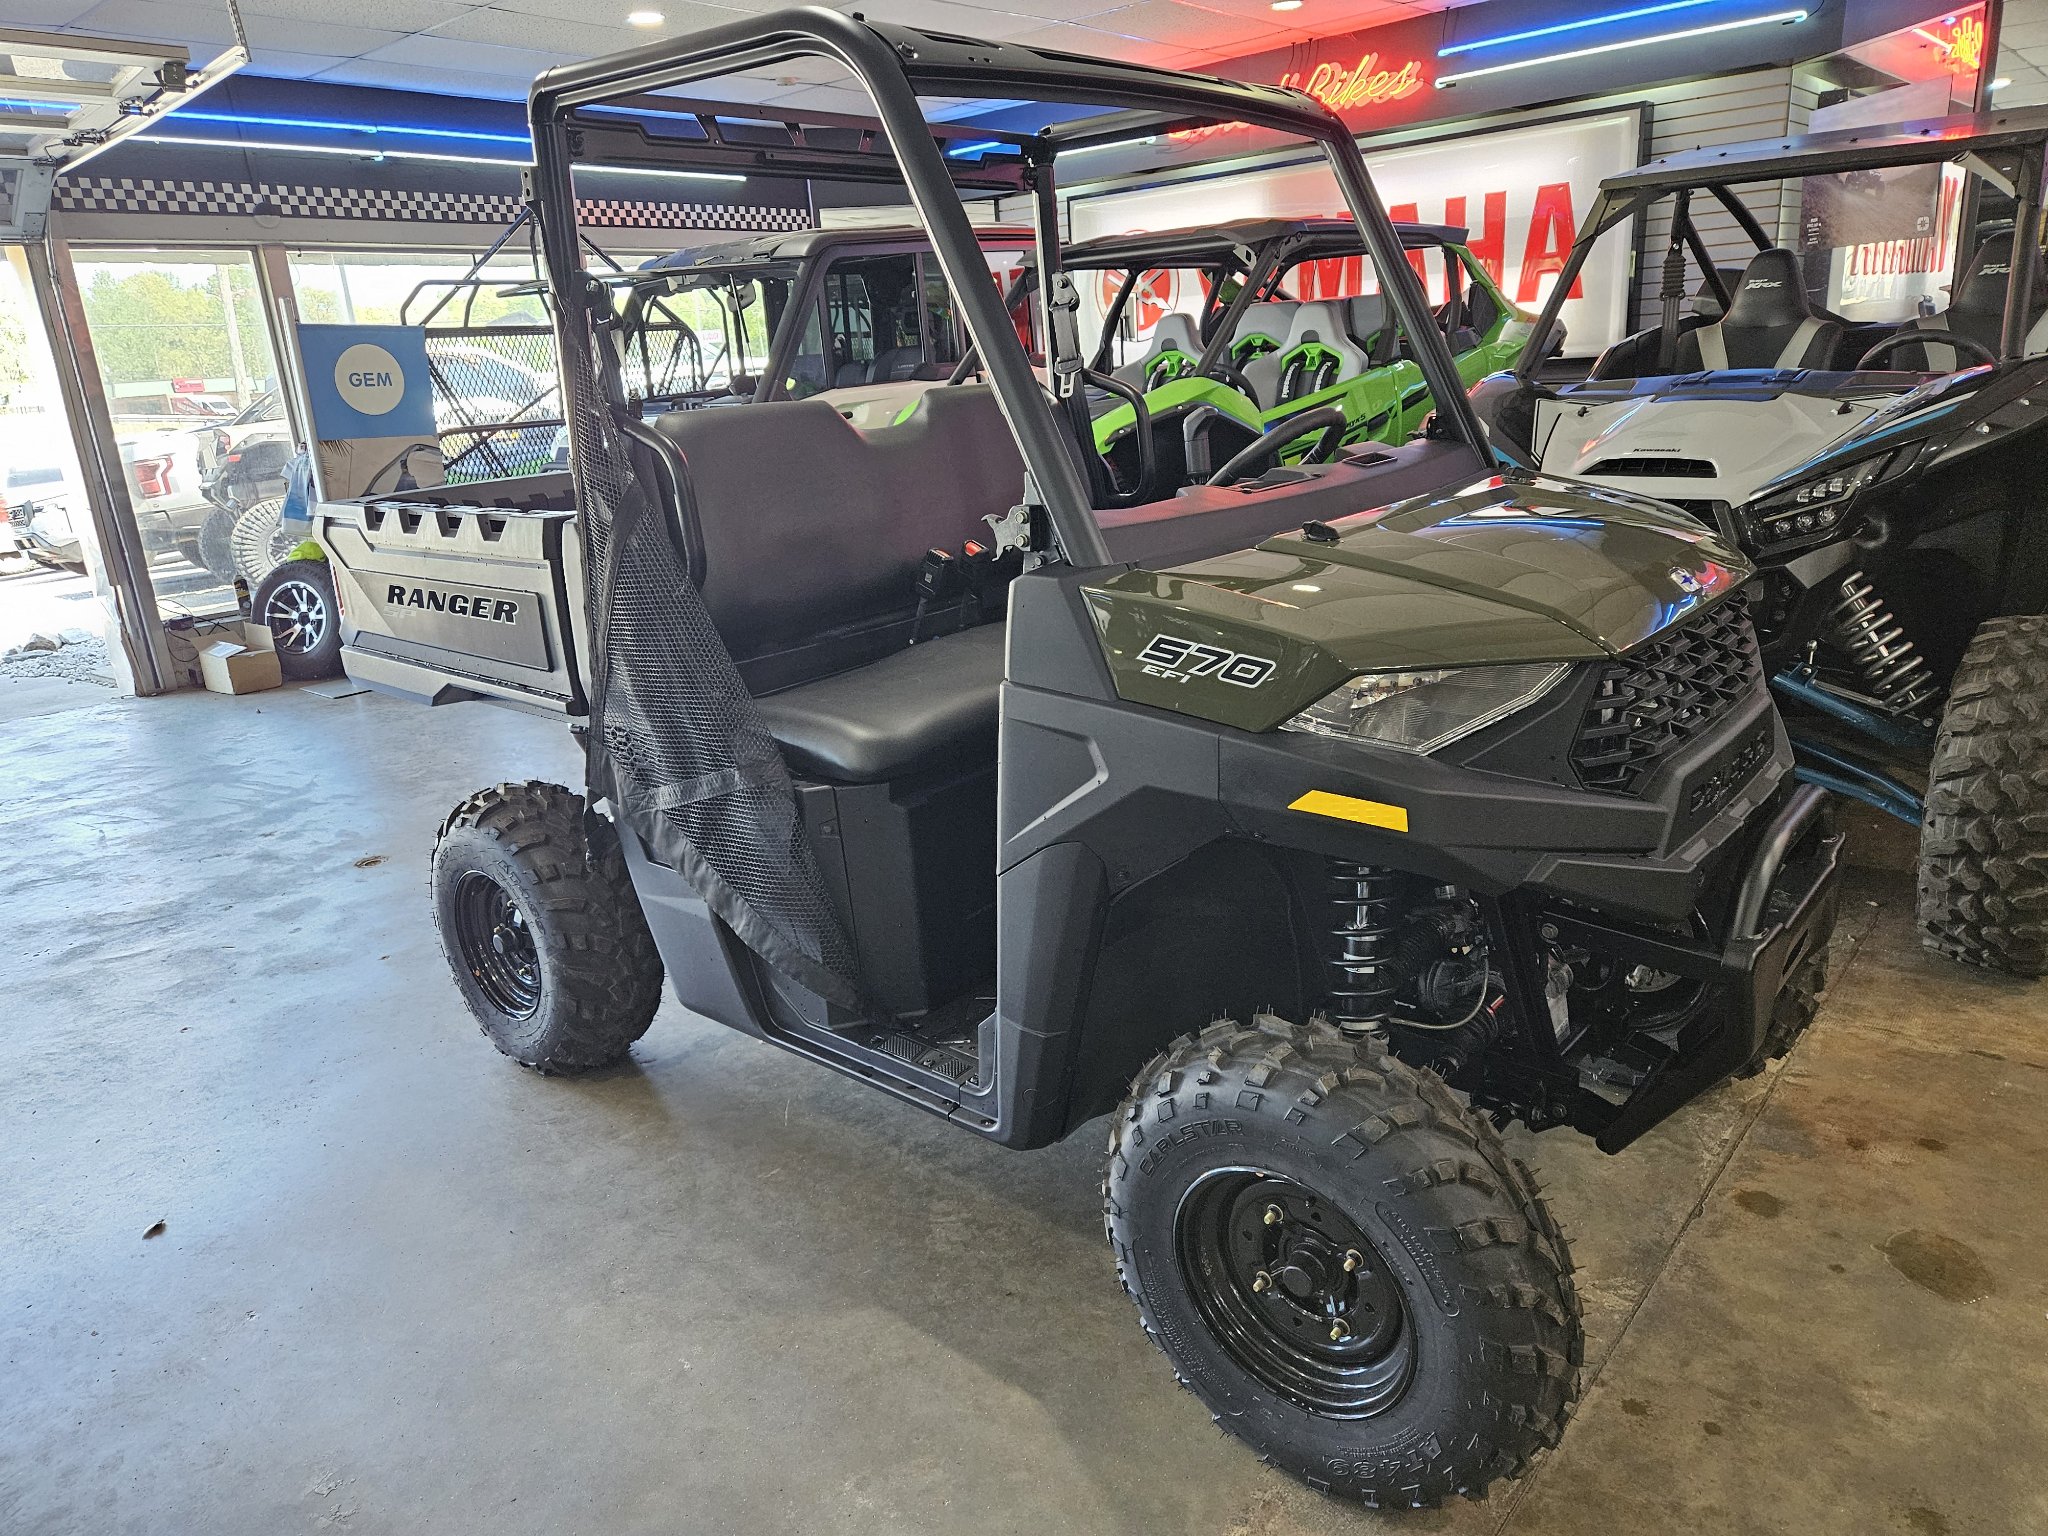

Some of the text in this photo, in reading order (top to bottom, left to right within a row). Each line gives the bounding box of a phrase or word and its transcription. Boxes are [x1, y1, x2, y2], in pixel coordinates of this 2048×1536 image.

[348, 372, 393, 387] GEM
[386, 584, 519, 625] RANGER
[1135, 633, 1277, 689] 570
[1141, 664, 1191, 683] EFI
